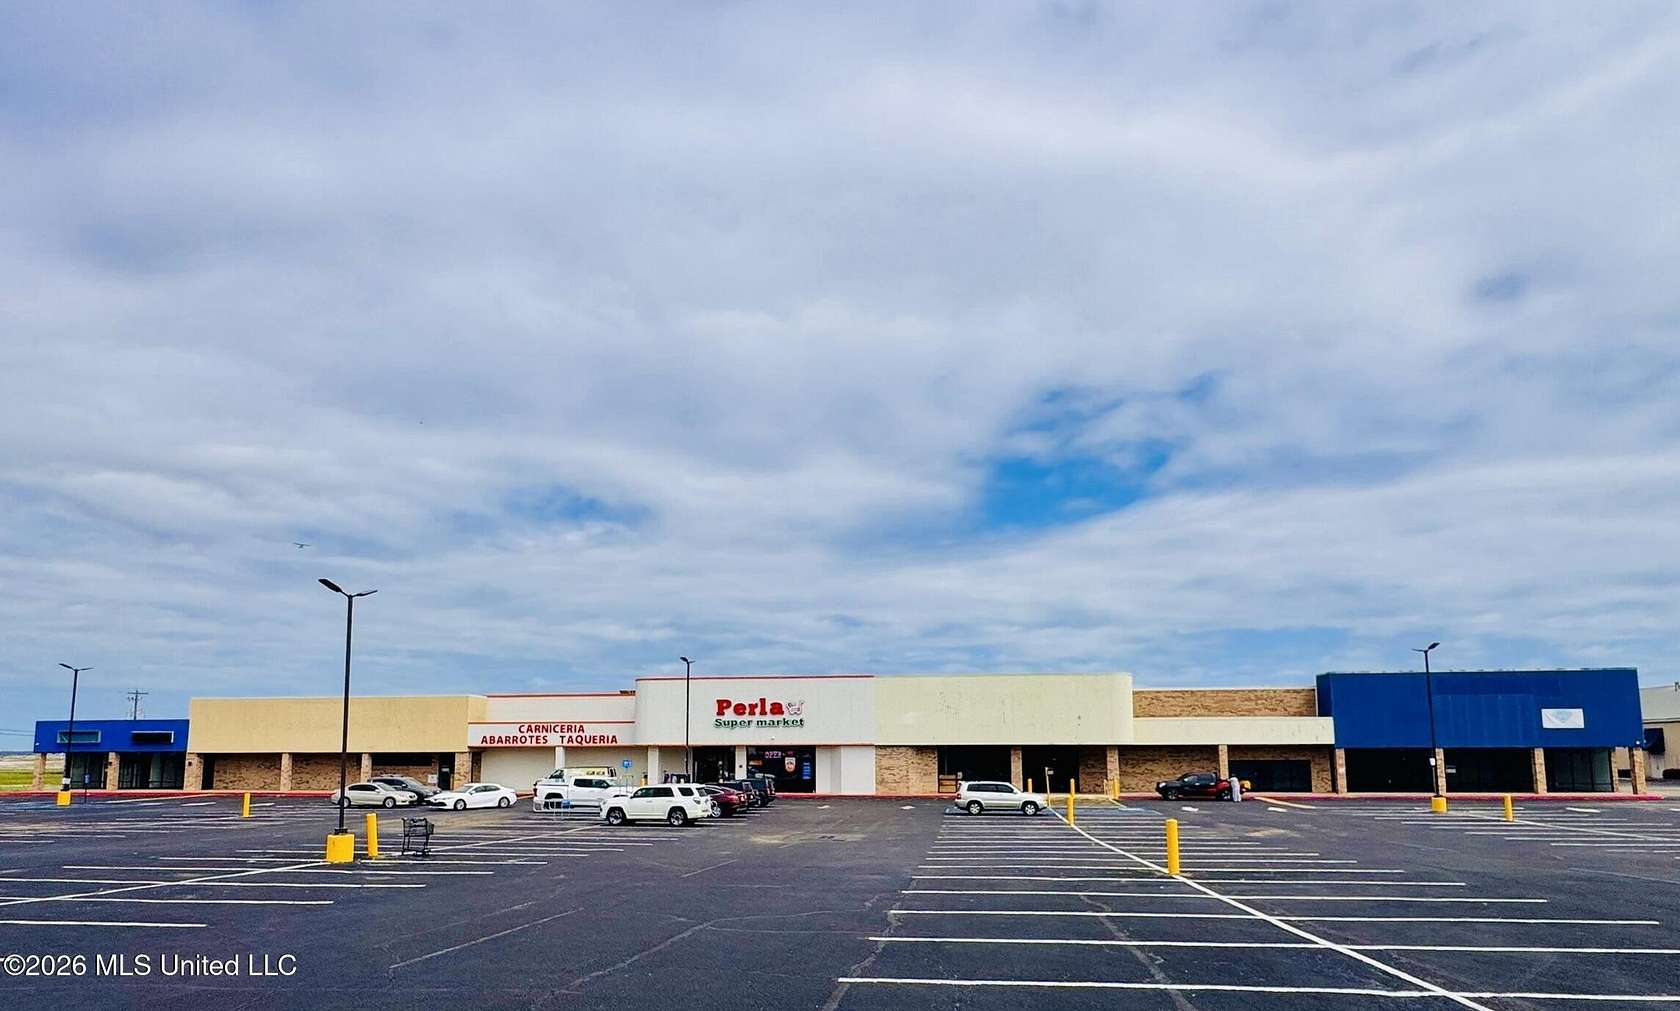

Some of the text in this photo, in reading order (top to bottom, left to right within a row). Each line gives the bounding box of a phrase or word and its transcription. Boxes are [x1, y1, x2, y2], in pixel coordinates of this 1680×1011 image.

[715, 698, 785, 717] Perla
[518, 724, 585, 734] CARNICERIA
[714, 718, 805, 729] Super market
[480, 735, 618, 746] ABARROTES TAQUERIA
